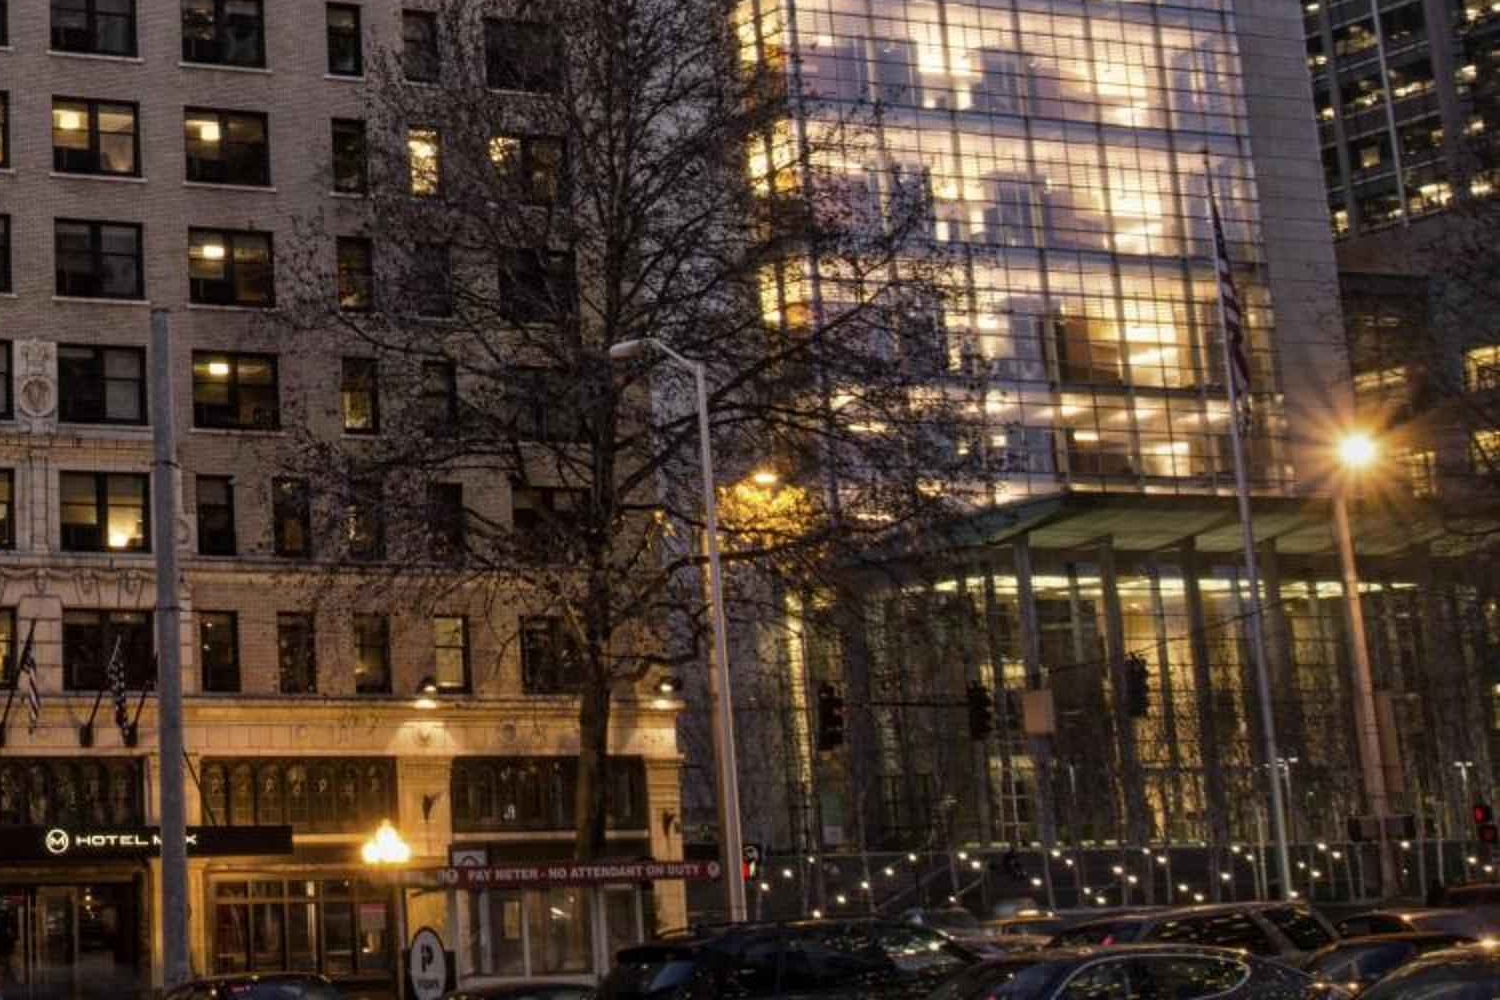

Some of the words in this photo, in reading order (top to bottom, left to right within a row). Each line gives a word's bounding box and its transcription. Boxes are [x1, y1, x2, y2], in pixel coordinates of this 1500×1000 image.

[75, 835, 149, 847] HOTEL
[468, 869, 493, 881] PAY
[548, 867, 567, 879] NO
[570, 865, 643, 878] ATTENDANT
[645, 864, 664, 877] ON
[667, 863, 699, 876] DUTY
